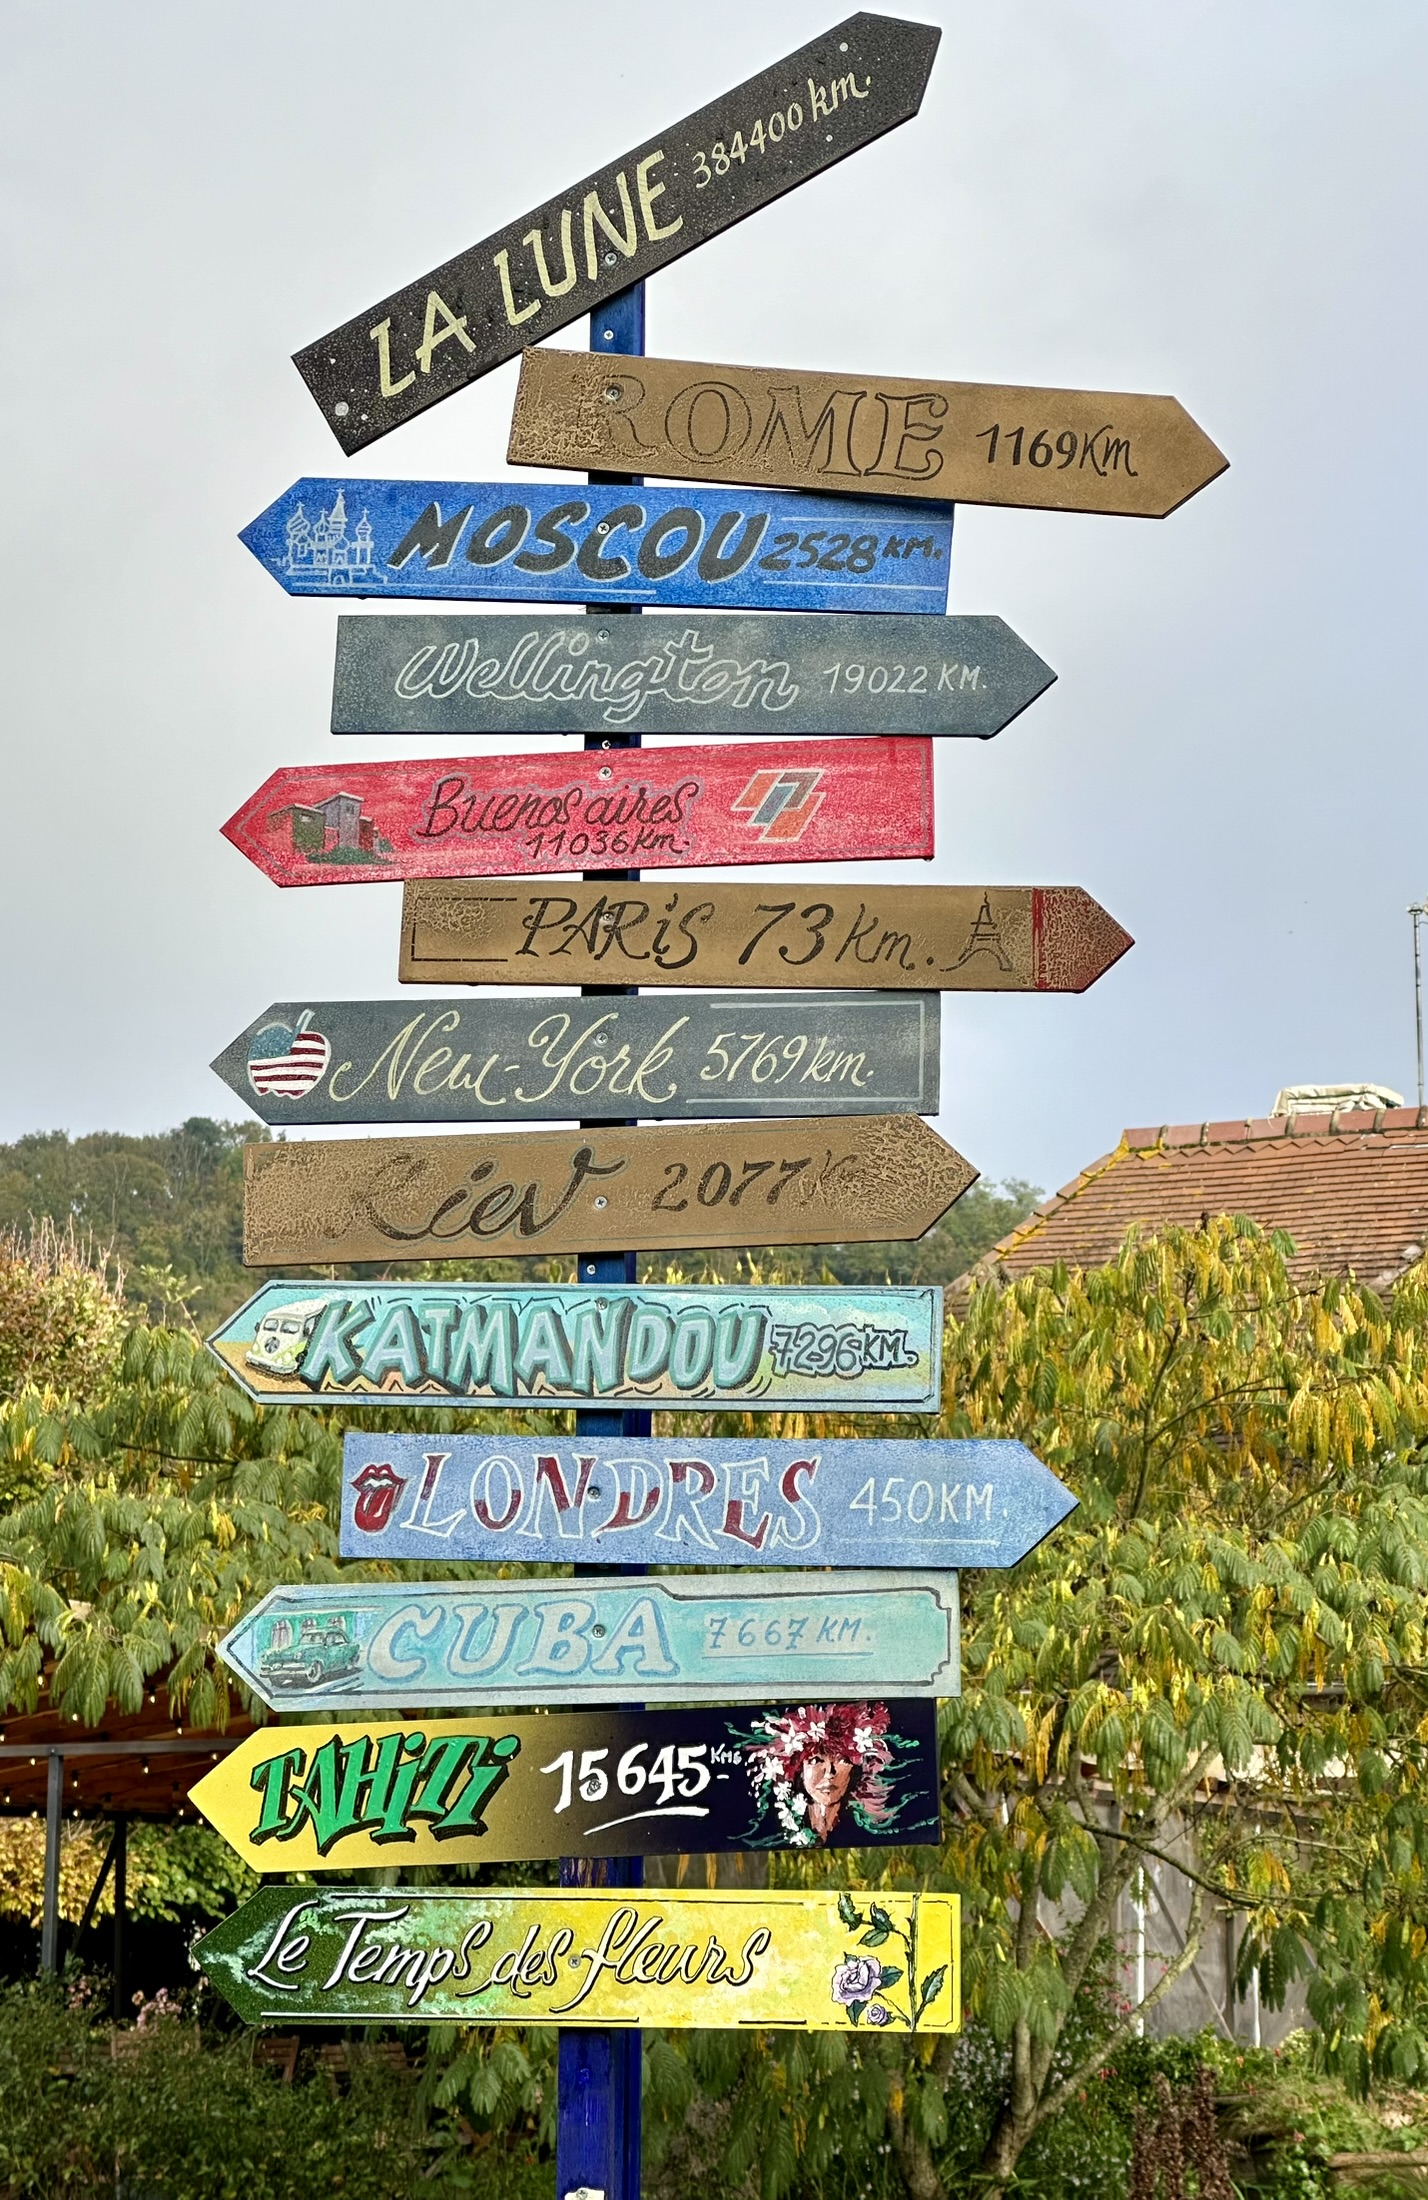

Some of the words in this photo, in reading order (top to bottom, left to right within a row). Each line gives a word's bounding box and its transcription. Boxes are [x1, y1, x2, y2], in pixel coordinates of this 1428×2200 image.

[369, 290, 477, 398] LA
[493, 149, 683, 326] LUNE
[692, 102, 804, 189] 384400
[592, 374, 950, 482] ROME
[387, 500, 770, 584] MOSCOU
[758, 531, 879, 573] 2528
[394, 630, 800, 723] Wellington
[823, 662, 928, 694] 19022
[415, 777, 583, 838] Buenos
[738, 902, 834, 965] 73
[328, 1010, 690, 1105] New-York
[651, 1151, 811, 1213] 2077
[299, 1296, 769, 1397] KATMANDOU
[400, 1451, 822, 1550] LONDRES
[364, 1597, 681, 1681] CUBA
[710, 1616, 809, 1650] 7667
[816, 1616, 872, 1643] KM.
[540, 1743, 711, 1814] 15645
[248, 1900, 319, 1990] Le
[320, 1904, 493, 2007] Temps
[455, 1924, 574, 1998] des
[549, 1906, 772, 2013] fleurs
